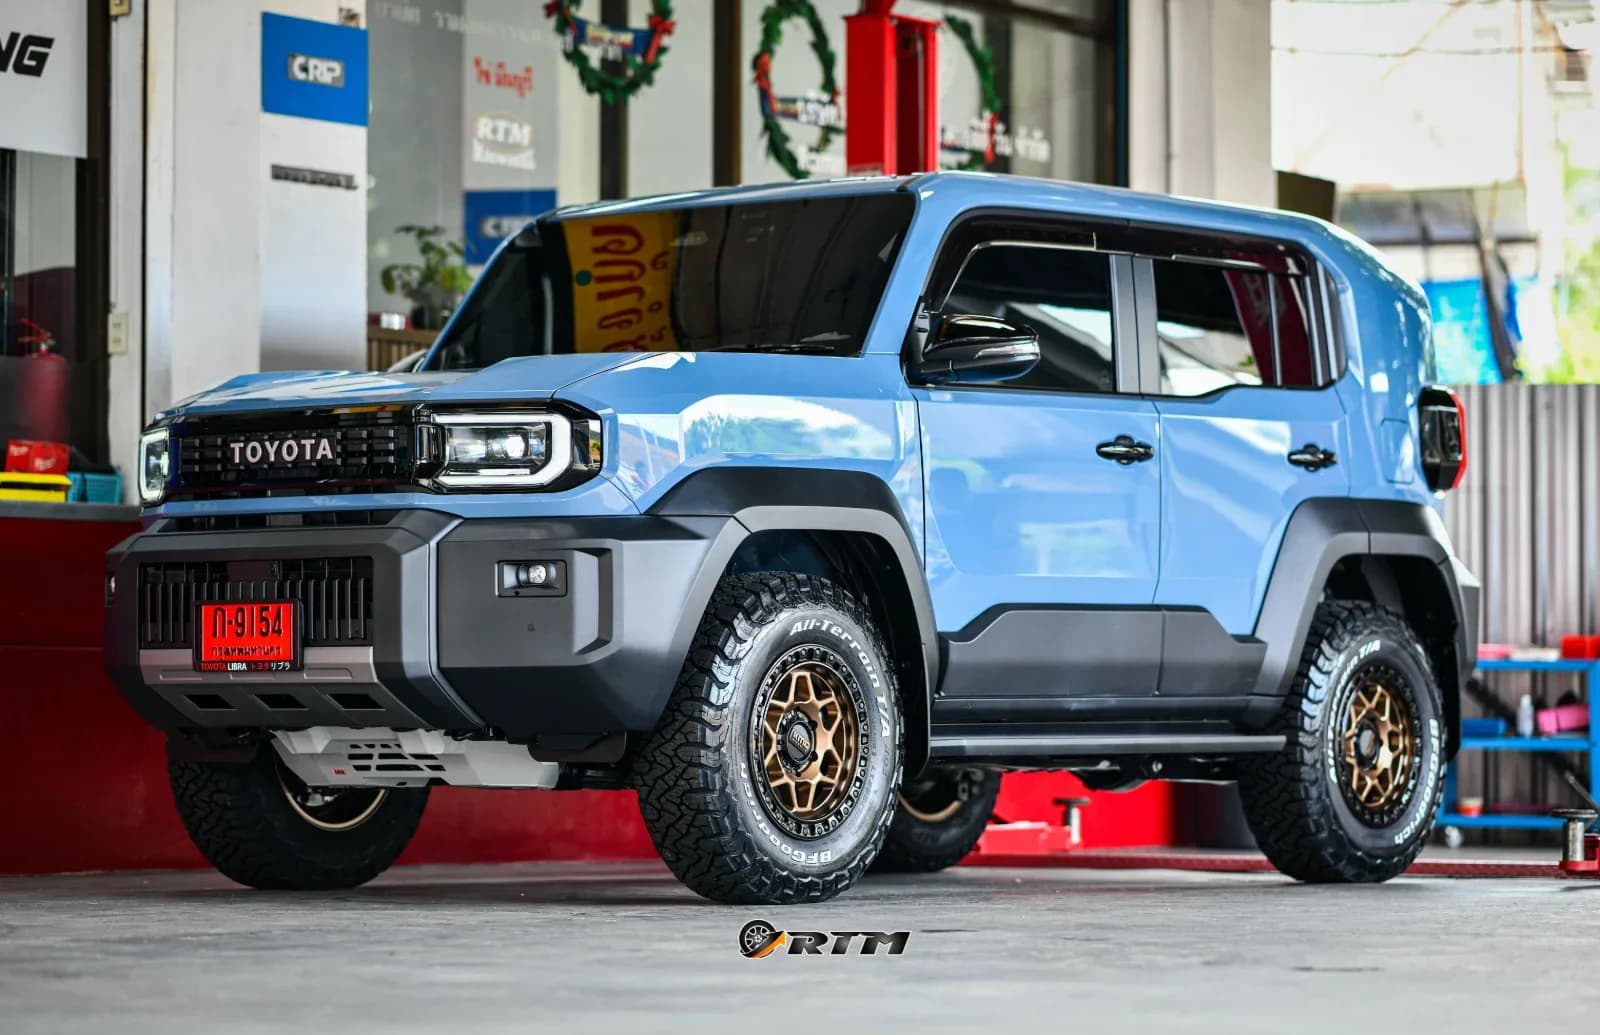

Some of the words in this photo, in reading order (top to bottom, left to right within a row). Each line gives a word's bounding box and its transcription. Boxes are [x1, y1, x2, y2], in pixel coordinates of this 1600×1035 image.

[477, 117, 532, 147] RTM
[230, 438, 334, 464] TOYOTA
[1359, 639, 1381, 659] T/A
[201, 662, 226, 672] TOYOTA
[227, 662, 248, 672] LIBRA
[270, 661, 291, 672] リブラ
[789, 619, 880, 689] All-Terrain
[877, 692, 891, 738] T/A
[1394, 718, 1440, 845] BFGoodrich
[740, 762, 833, 865] BFGoodrich
